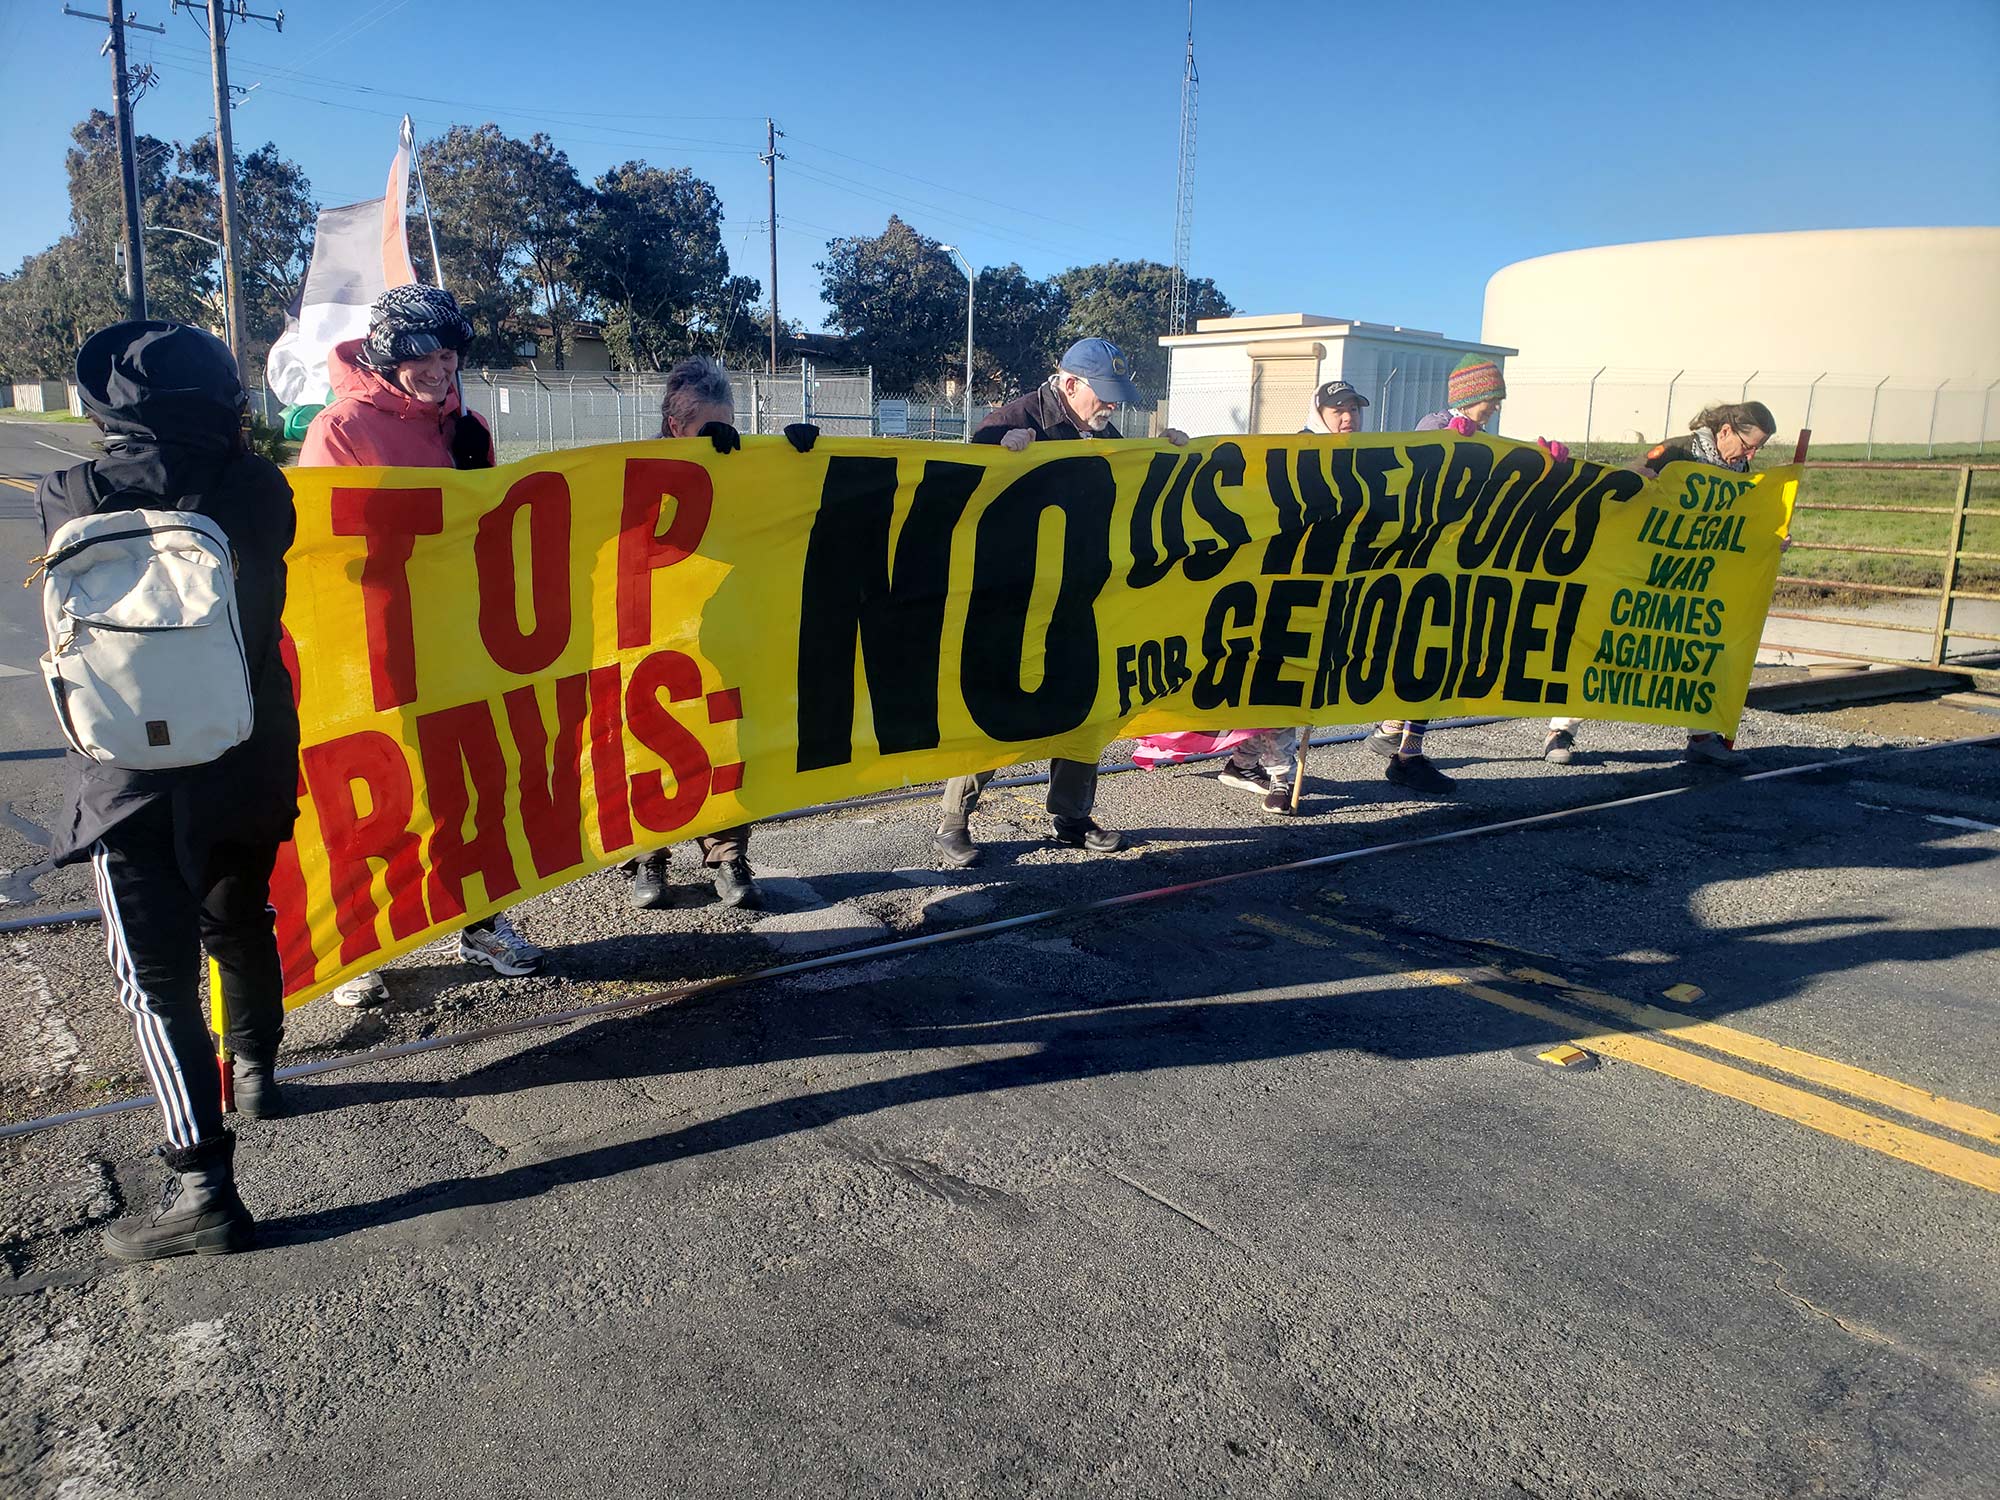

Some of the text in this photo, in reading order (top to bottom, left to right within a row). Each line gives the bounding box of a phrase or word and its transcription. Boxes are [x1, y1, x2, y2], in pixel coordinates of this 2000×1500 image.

[1126, 442, 1644, 588] US WEAPONS
[1637, 507, 1746, 553] ILLEGAL
[280, 458, 714, 712] TOP
[1646, 553, 1715, 592] WAR
[796, 456, 1117, 773] NO
[1610, 588, 1725, 637] CRIMES
[1116, 573, 1588, 718] FOR GENOCIDE!
[1593, 629, 1725, 676] AGAINST
[1582, 666, 1716, 714] CIVILIANS
